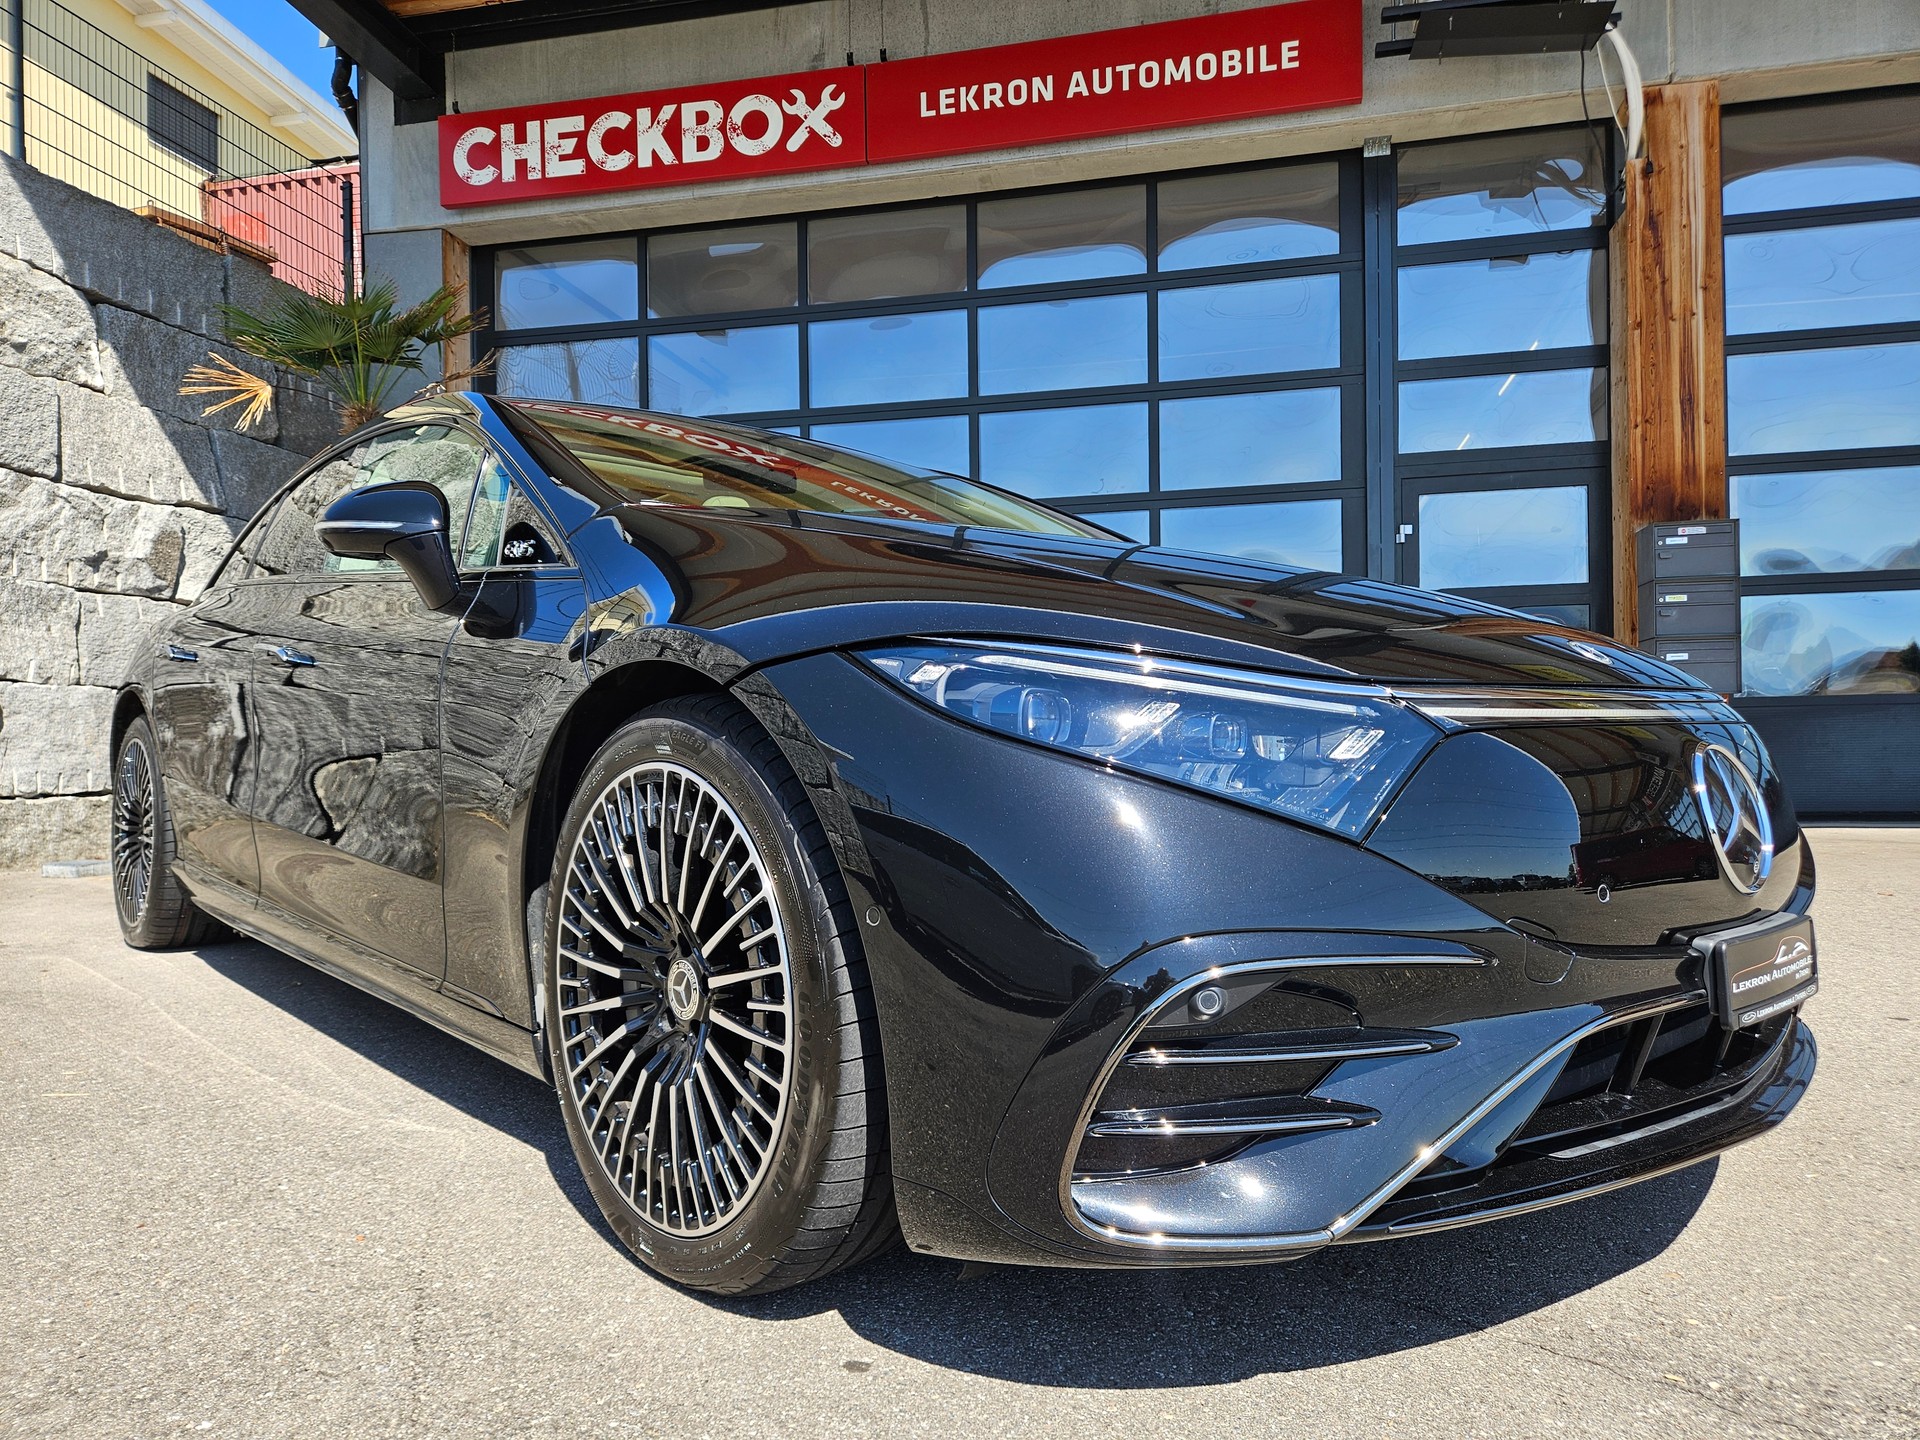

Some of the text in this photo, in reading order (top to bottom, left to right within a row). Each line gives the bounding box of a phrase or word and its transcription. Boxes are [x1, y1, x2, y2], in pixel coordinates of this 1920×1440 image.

[920, 40, 1299, 117] LEKRON AUTOMOBILE
[453, 84, 845, 186] CHECKBOX
[671, 730, 695, 745] EAGLE
[1733, 955, 1813, 993] LEKRON AUTOMOBILE
[771, 991, 812, 1198] GOODYEAR
